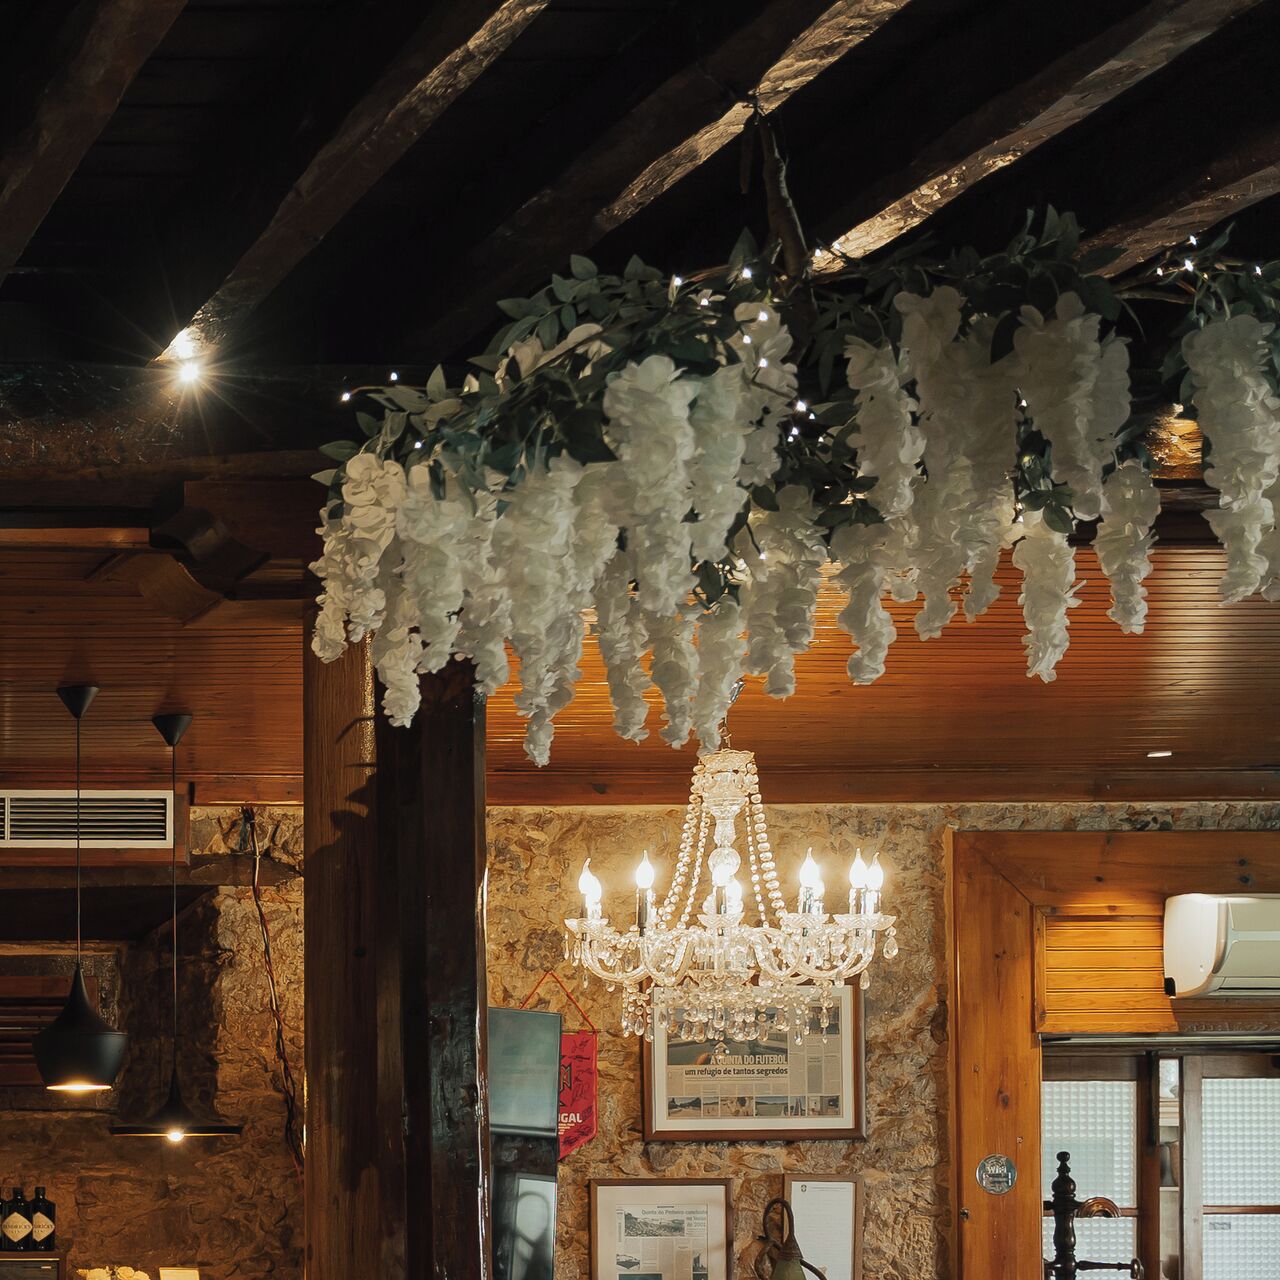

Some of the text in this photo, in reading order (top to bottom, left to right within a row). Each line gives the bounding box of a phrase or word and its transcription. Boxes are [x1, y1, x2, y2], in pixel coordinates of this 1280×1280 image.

[744, 1055, 755, 1065] DO
[756, 1055, 788, 1065] FUTEBOL
[756, 1067, 788, 1076] segredos
